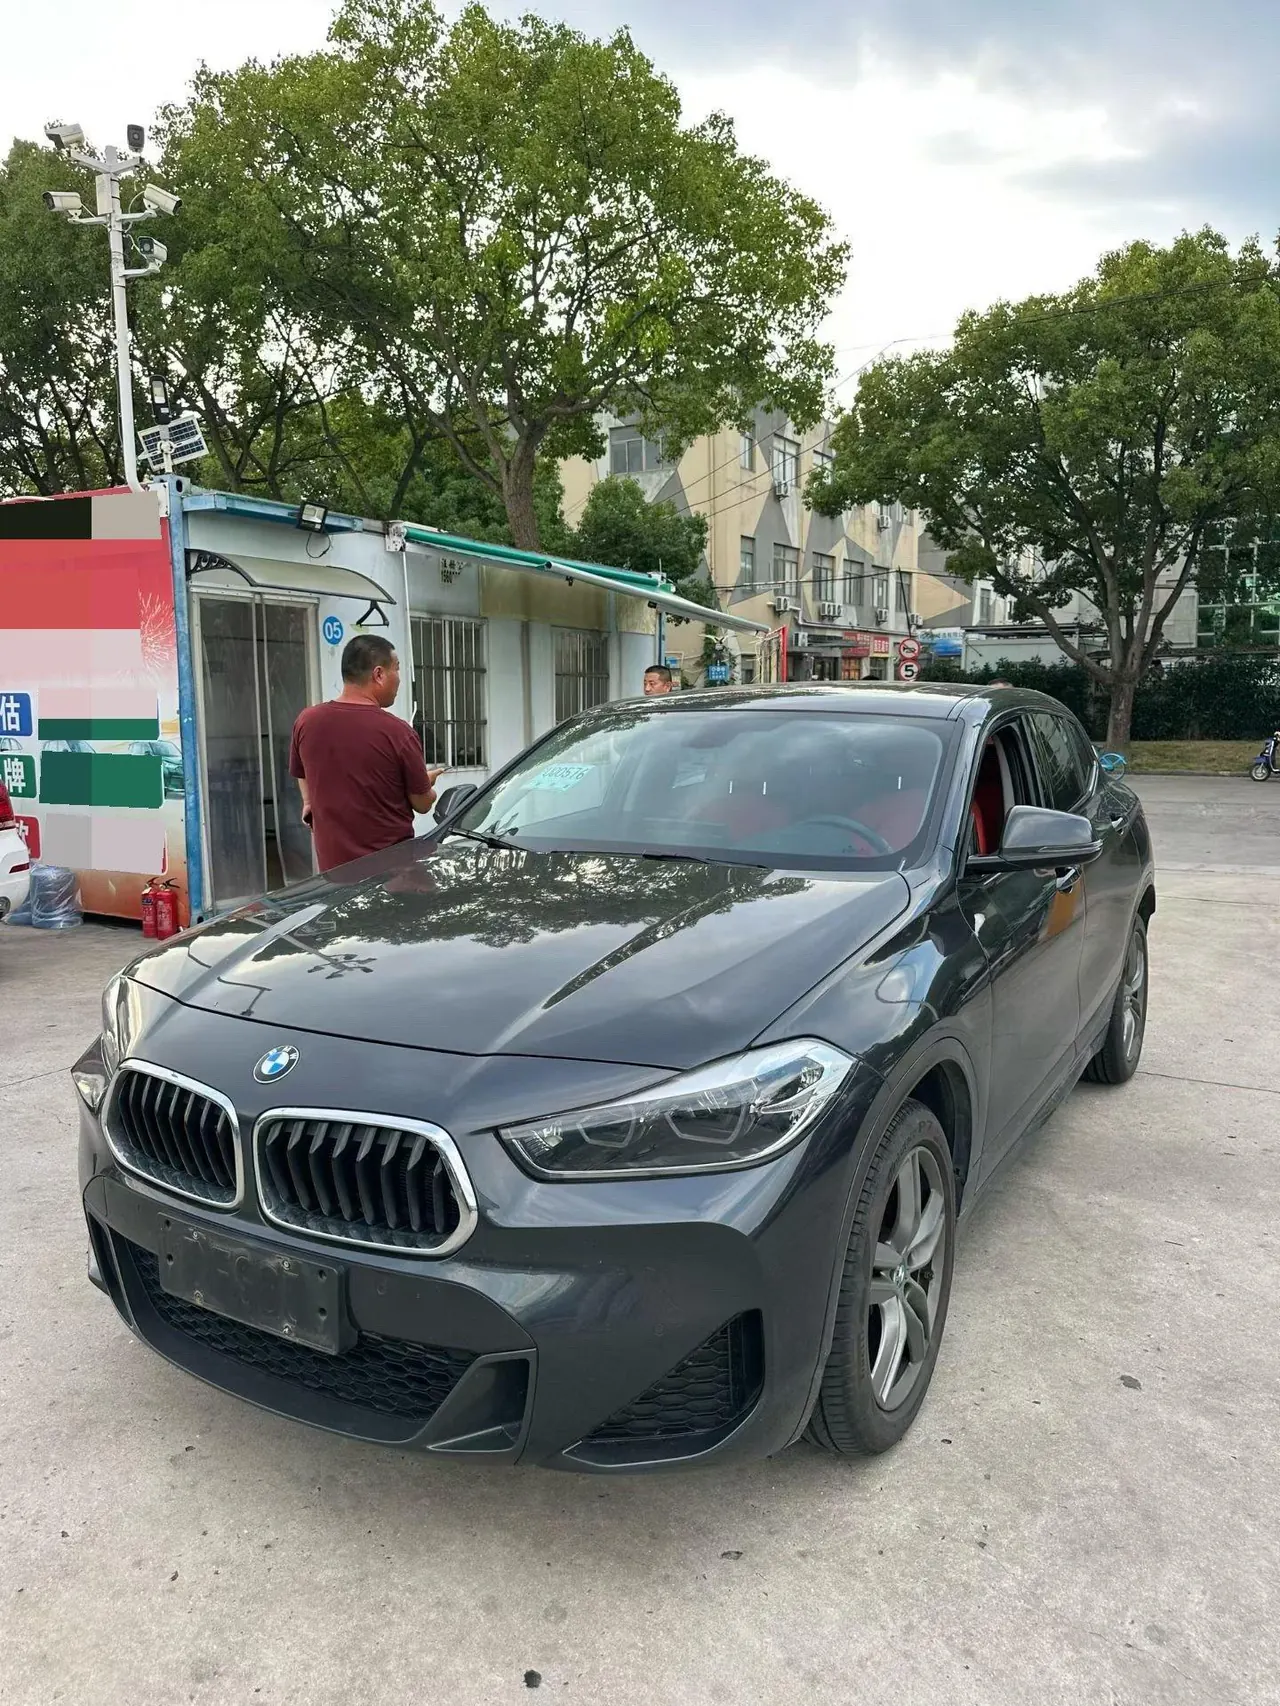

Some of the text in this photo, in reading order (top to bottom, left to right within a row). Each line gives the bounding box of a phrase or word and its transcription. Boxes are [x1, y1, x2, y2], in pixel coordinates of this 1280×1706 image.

[325, 621, 342, 639] 05
[905, 664, 914, 678] 5
[0, 695, 21, 731] 估
[0, 757, 26, 793] 牌
